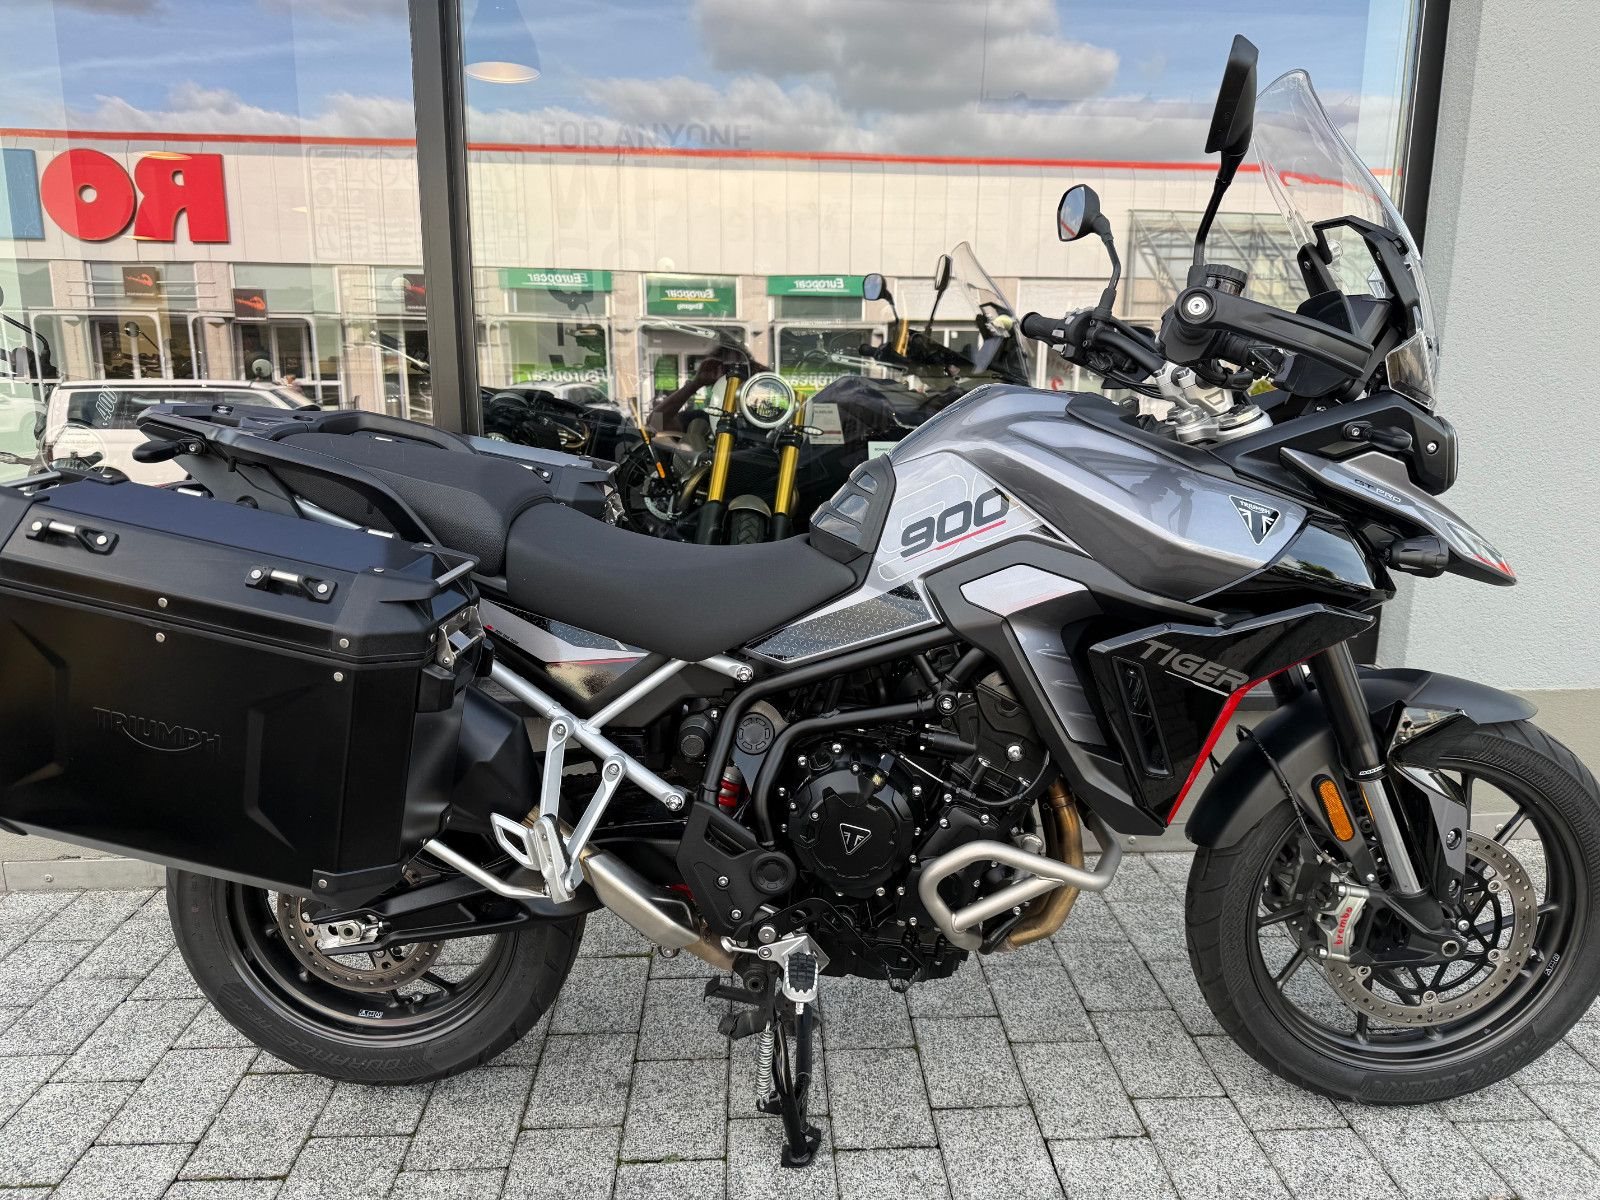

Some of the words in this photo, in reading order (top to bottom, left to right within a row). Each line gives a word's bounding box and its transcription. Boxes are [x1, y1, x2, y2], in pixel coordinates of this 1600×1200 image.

[539, 121, 605, 149] FOR
[616, 122, 752, 151] ANYONE
[1239, 499, 1271, 515] TRIUMPH
[1354, 478, 1374, 489] GT
[1375, 487, 1401, 503] PRO
[900, 487, 1010, 558] 900
[1140, 639, 1250, 692] TIGER
[93, 706, 221, 755] TRIUMPH
[1333, 906, 1353, 945] brembo
